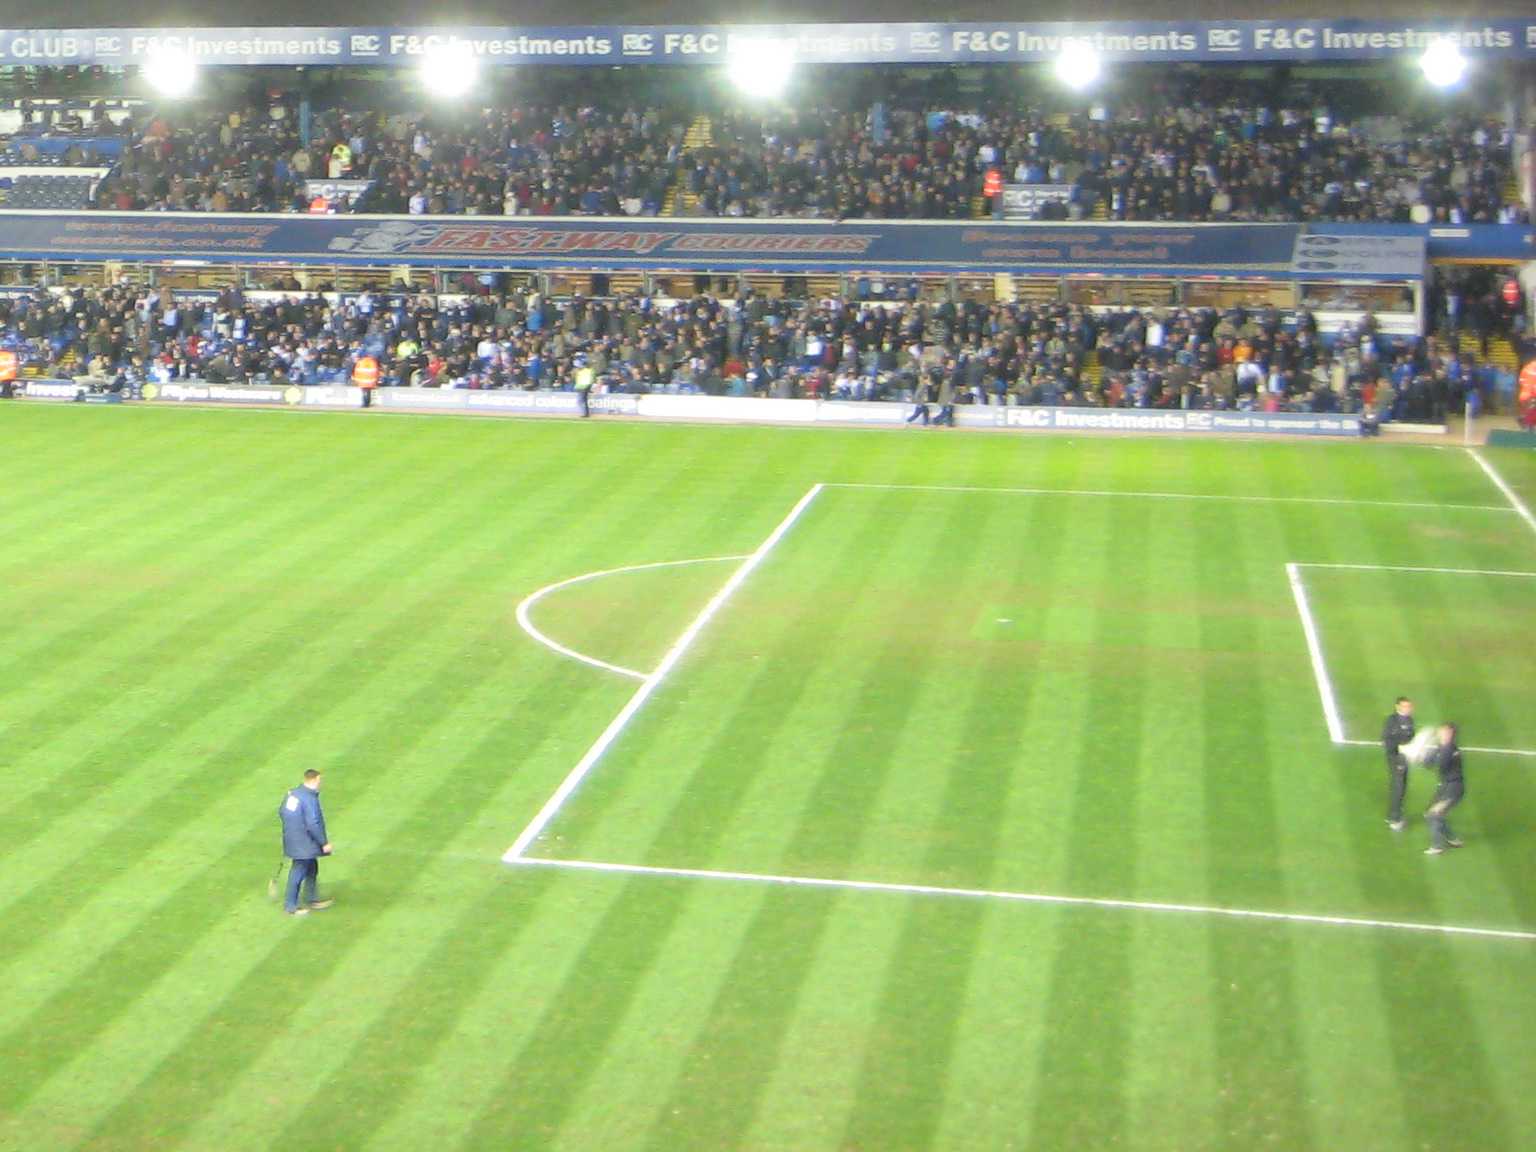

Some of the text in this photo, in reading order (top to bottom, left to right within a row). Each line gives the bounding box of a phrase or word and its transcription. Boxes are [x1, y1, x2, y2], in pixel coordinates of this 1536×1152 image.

[10, 34, 80, 57] CLUB
[131, 35, 182, 57] F&C
[186, 35, 341, 56] Investments
[389, 33, 438, 55] F&C
[448, 32, 612, 55] Investments
[663, 32, 720, 55] F&C
[726, 31, 895, 54] Istments
[951, 30, 1010, 53] F&C
[1017, 29, 1198, 52] Investments
[1252, 27, 1315, 51] F&C
[1321, 26, 1512, 50] Investments
[426, 229, 873, 253] FASTWAY COURIERS
[26, 381, 80, 398] Invest
[468, 394, 636, 413] advanced colour oatings
[1007, 409, 1050, 426] F&C
[1055, 410, 1185, 429] Investments
[1214, 416, 1249, 428] Proud
[1267, 419, 1316, 431] sponsor
